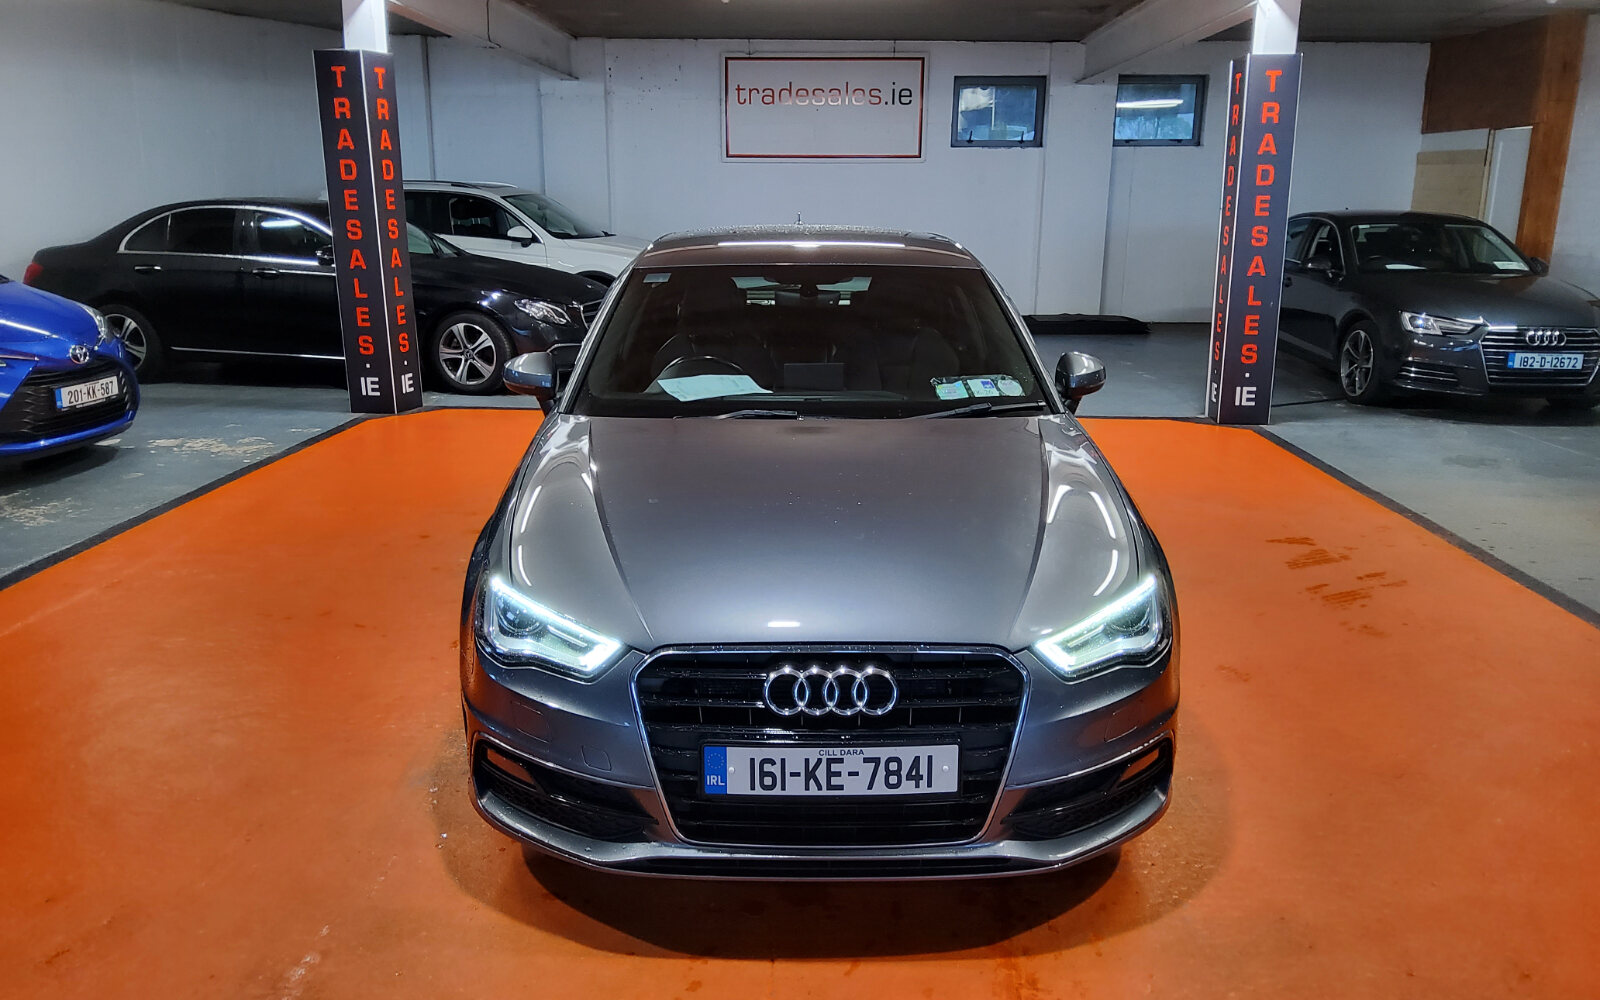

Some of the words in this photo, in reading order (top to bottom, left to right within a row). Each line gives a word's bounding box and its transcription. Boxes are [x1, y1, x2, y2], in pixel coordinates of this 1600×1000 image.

[735, 81, 913, 106] tradesales.ie
[1519, 355, 1579, 369] 182-D-12672
[67, 380, 114, 405] 201-KK-587
[818, 749, 838, 757] CILL
[839, 749, 865, 757] DARA
[706, 774, 726, 787] IRL
[749, 754, 933, 792] 161-KE-7841
